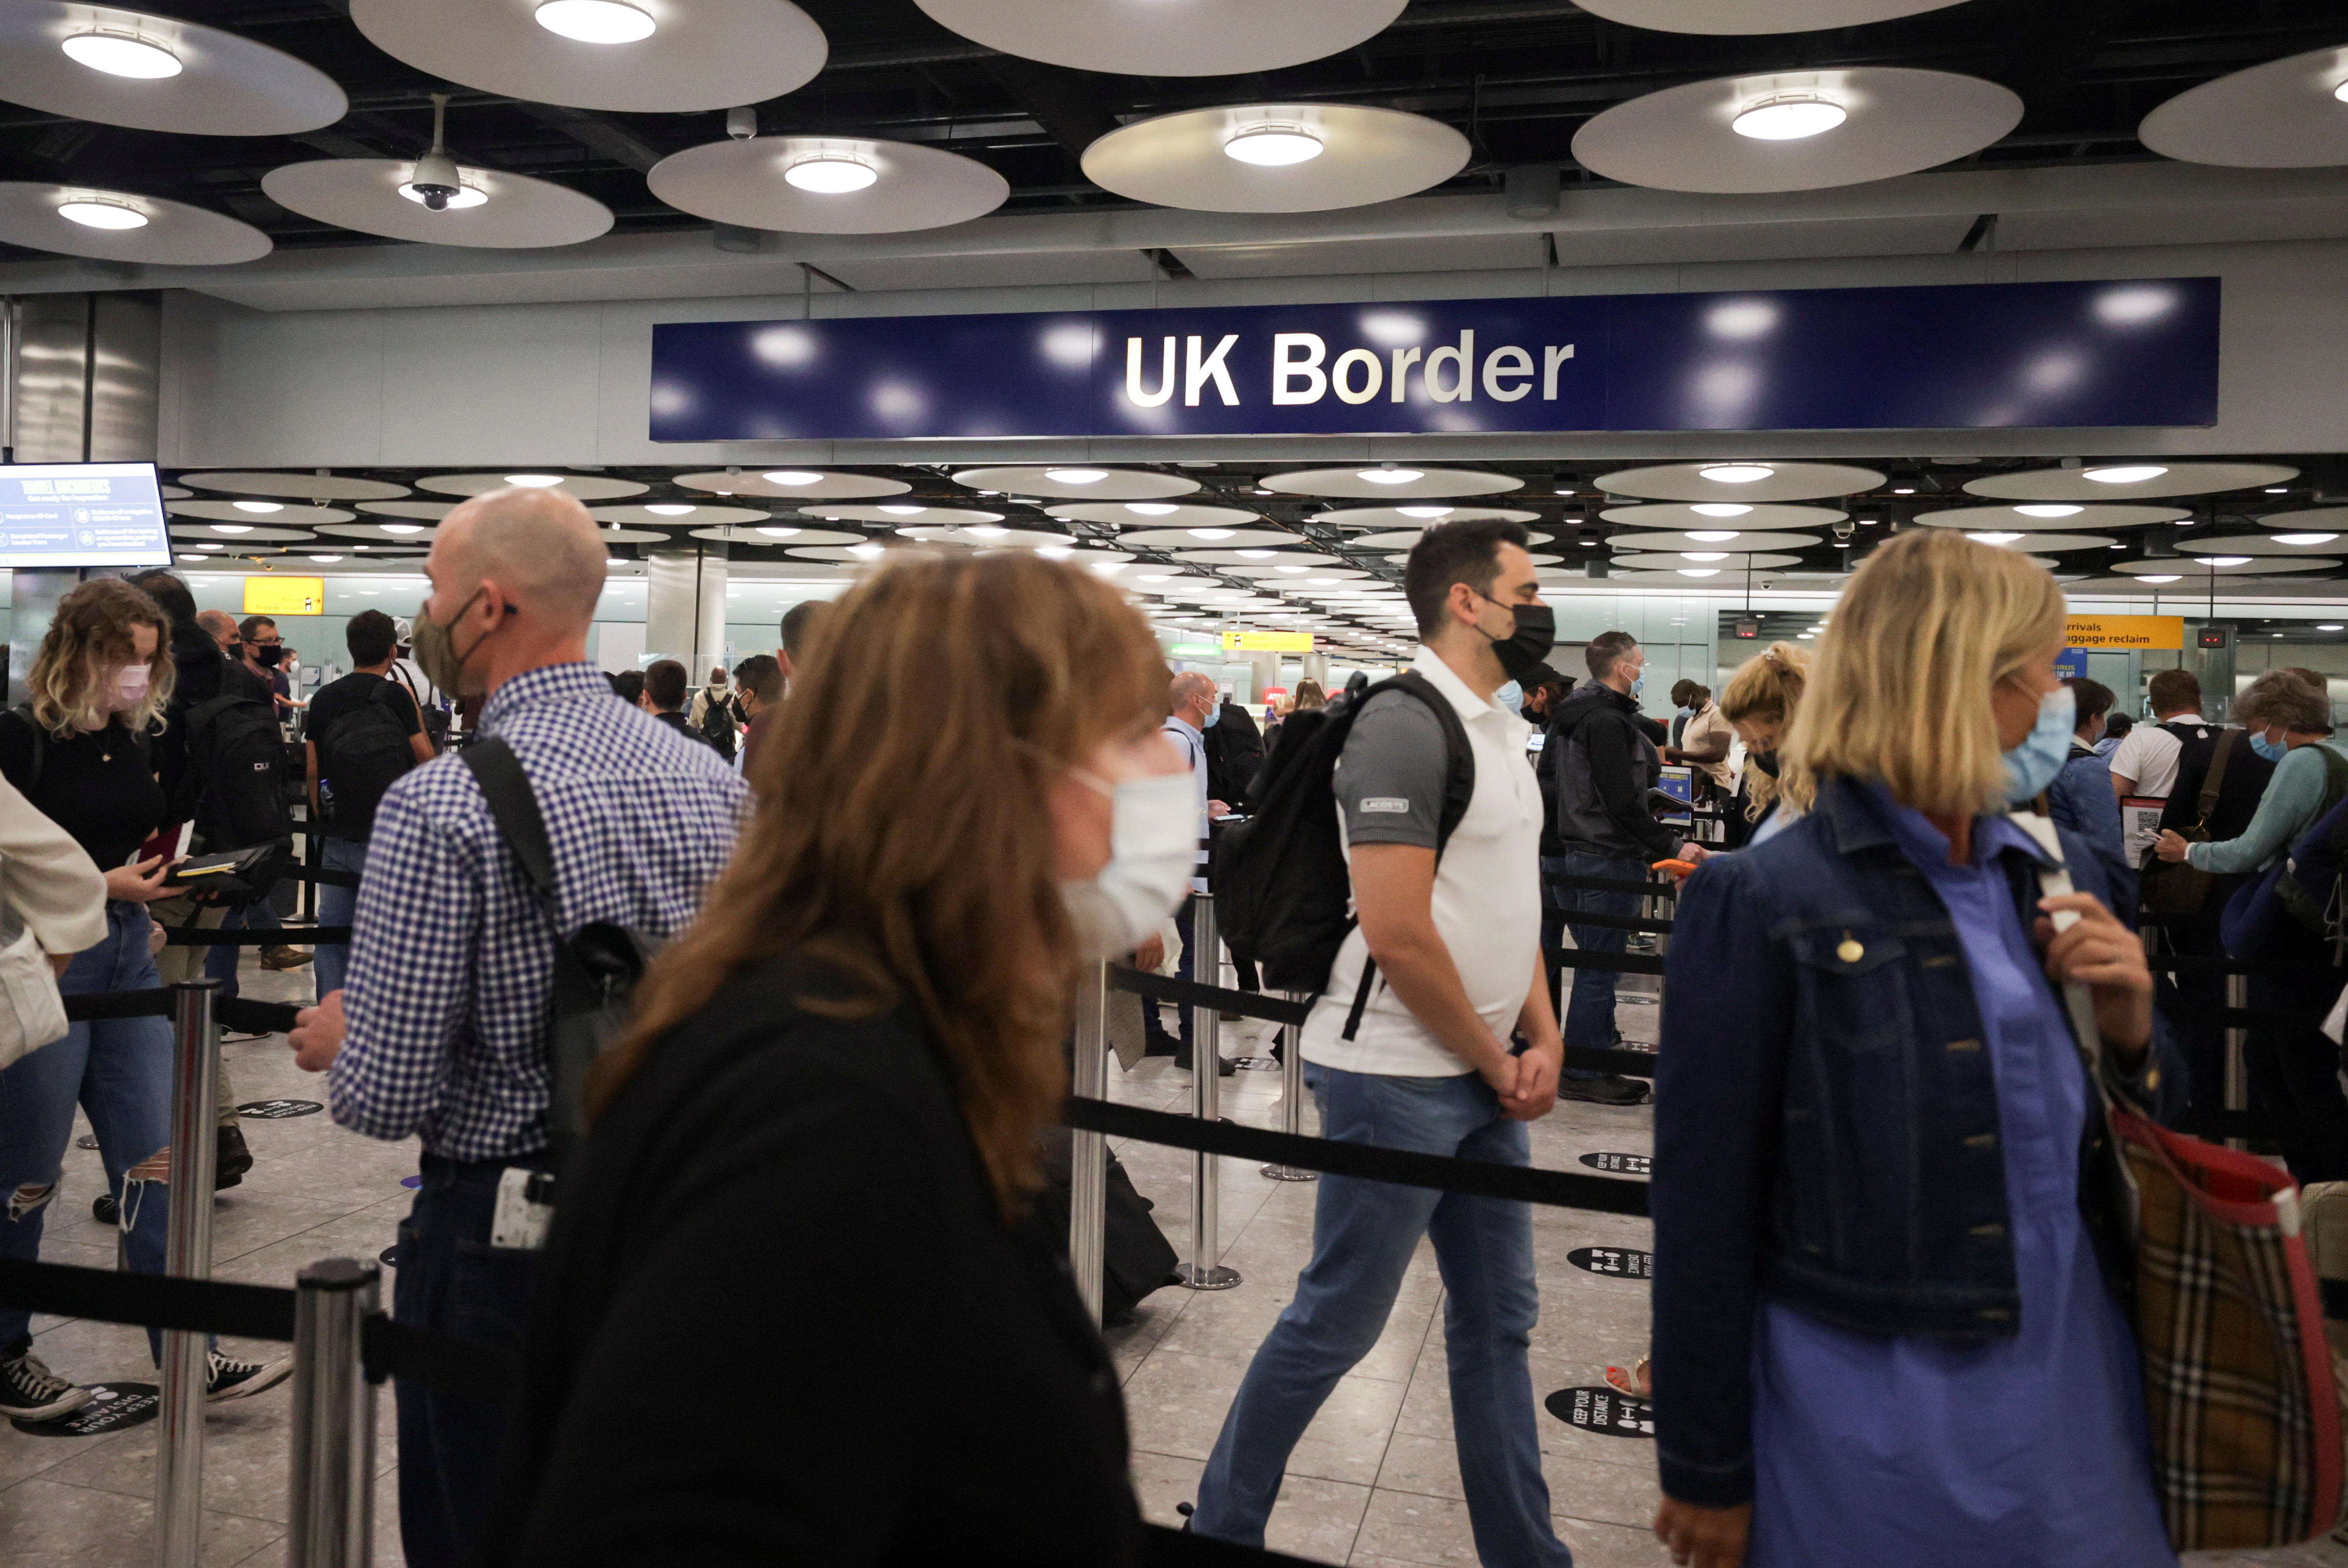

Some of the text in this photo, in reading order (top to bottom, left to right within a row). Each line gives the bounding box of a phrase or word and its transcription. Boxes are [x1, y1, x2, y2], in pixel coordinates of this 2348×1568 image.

[1126, 329, 1575, 408] UK Border
[21, 479, 111, 495] TRAVEL DOCUMENTS
[2066, 623, 2101, 631] rrivals
[2066, 634, 2150, 644] aggage reclaim
[1628, 1254, 1640, 1274] DISTANCE
[65, 1395, 142, 1428] DISTANCE
[77, 1395, 159, 1432] KEEP YOUR
[1573, 1390, 1590, 1424] KEEP YOUR
[1593, 1394, 1609, 1425] DISTANCE
